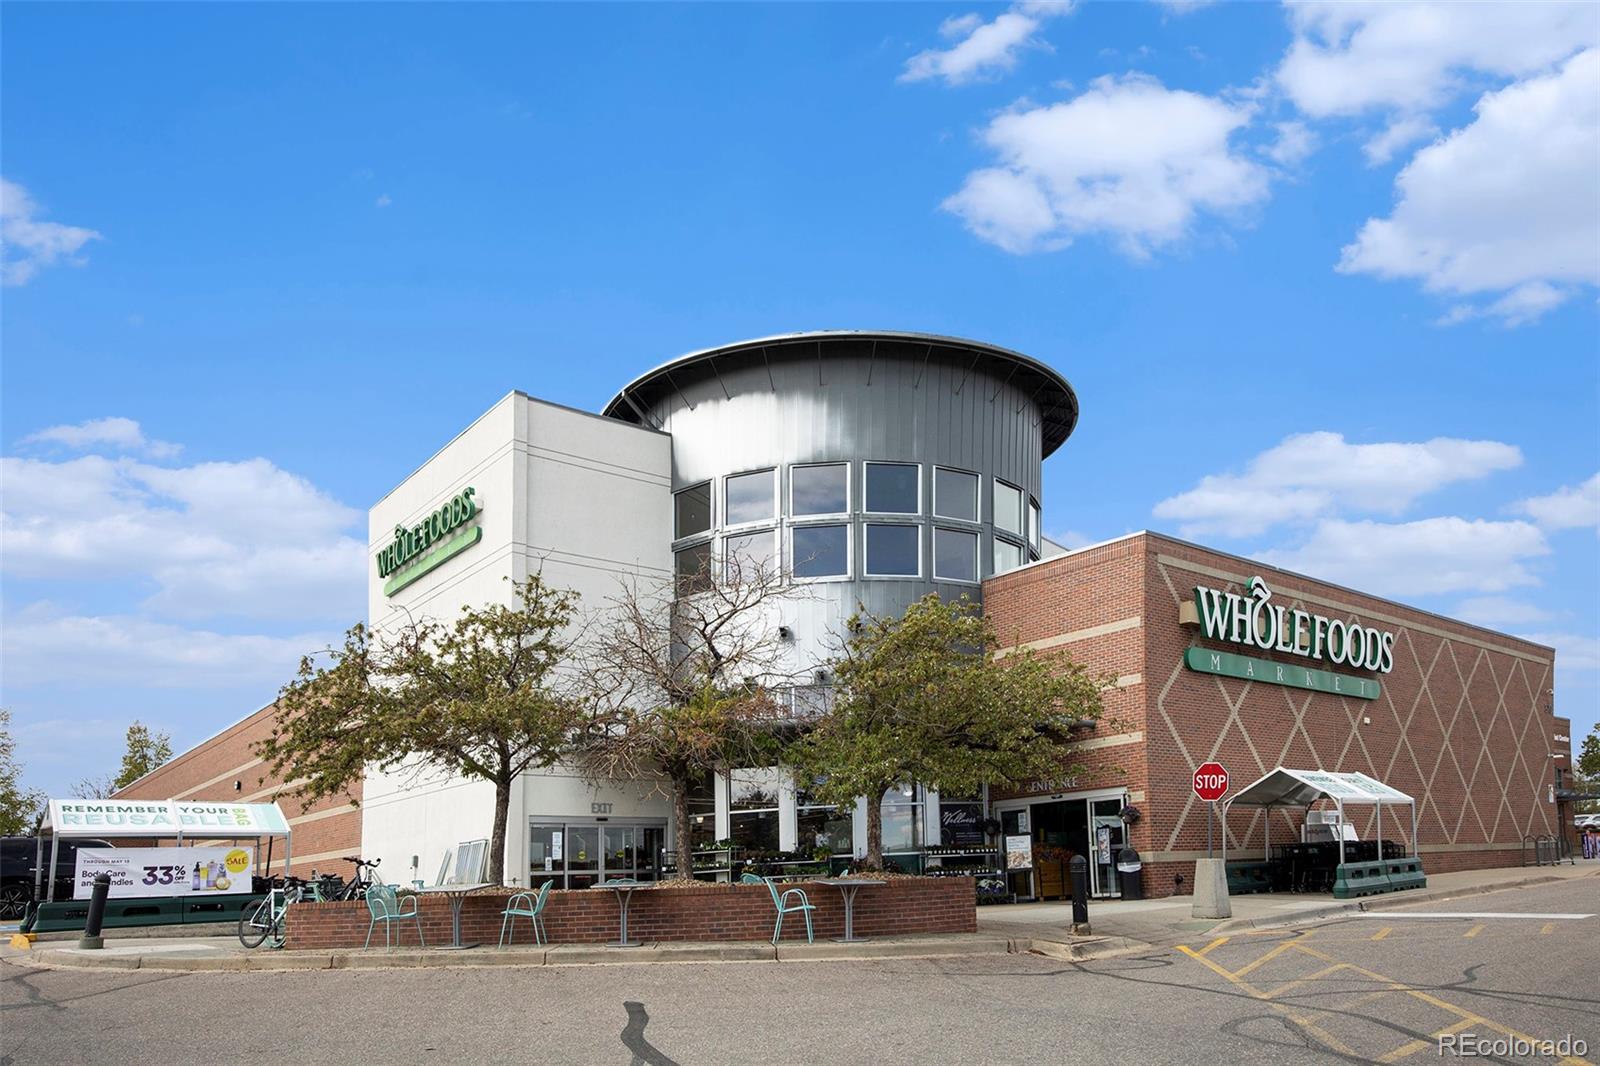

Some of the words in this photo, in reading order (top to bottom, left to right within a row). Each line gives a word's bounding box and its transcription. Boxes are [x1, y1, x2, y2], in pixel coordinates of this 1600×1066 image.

[1210, 653, 1367, 696] MARKET
[1195, 774, 1226, 789] STOP
[62, 804, 169, 814] REMEMBER
[179, 806, 229, 815] YOUR
[591, 803, 613, 814] EXIT
[62, 813, 236, 826] REUSABLE
[232, 807, 252, 827] BAG
[943, 809, 976, 825] Wellness
[226, 857, 248, 866] SALE
